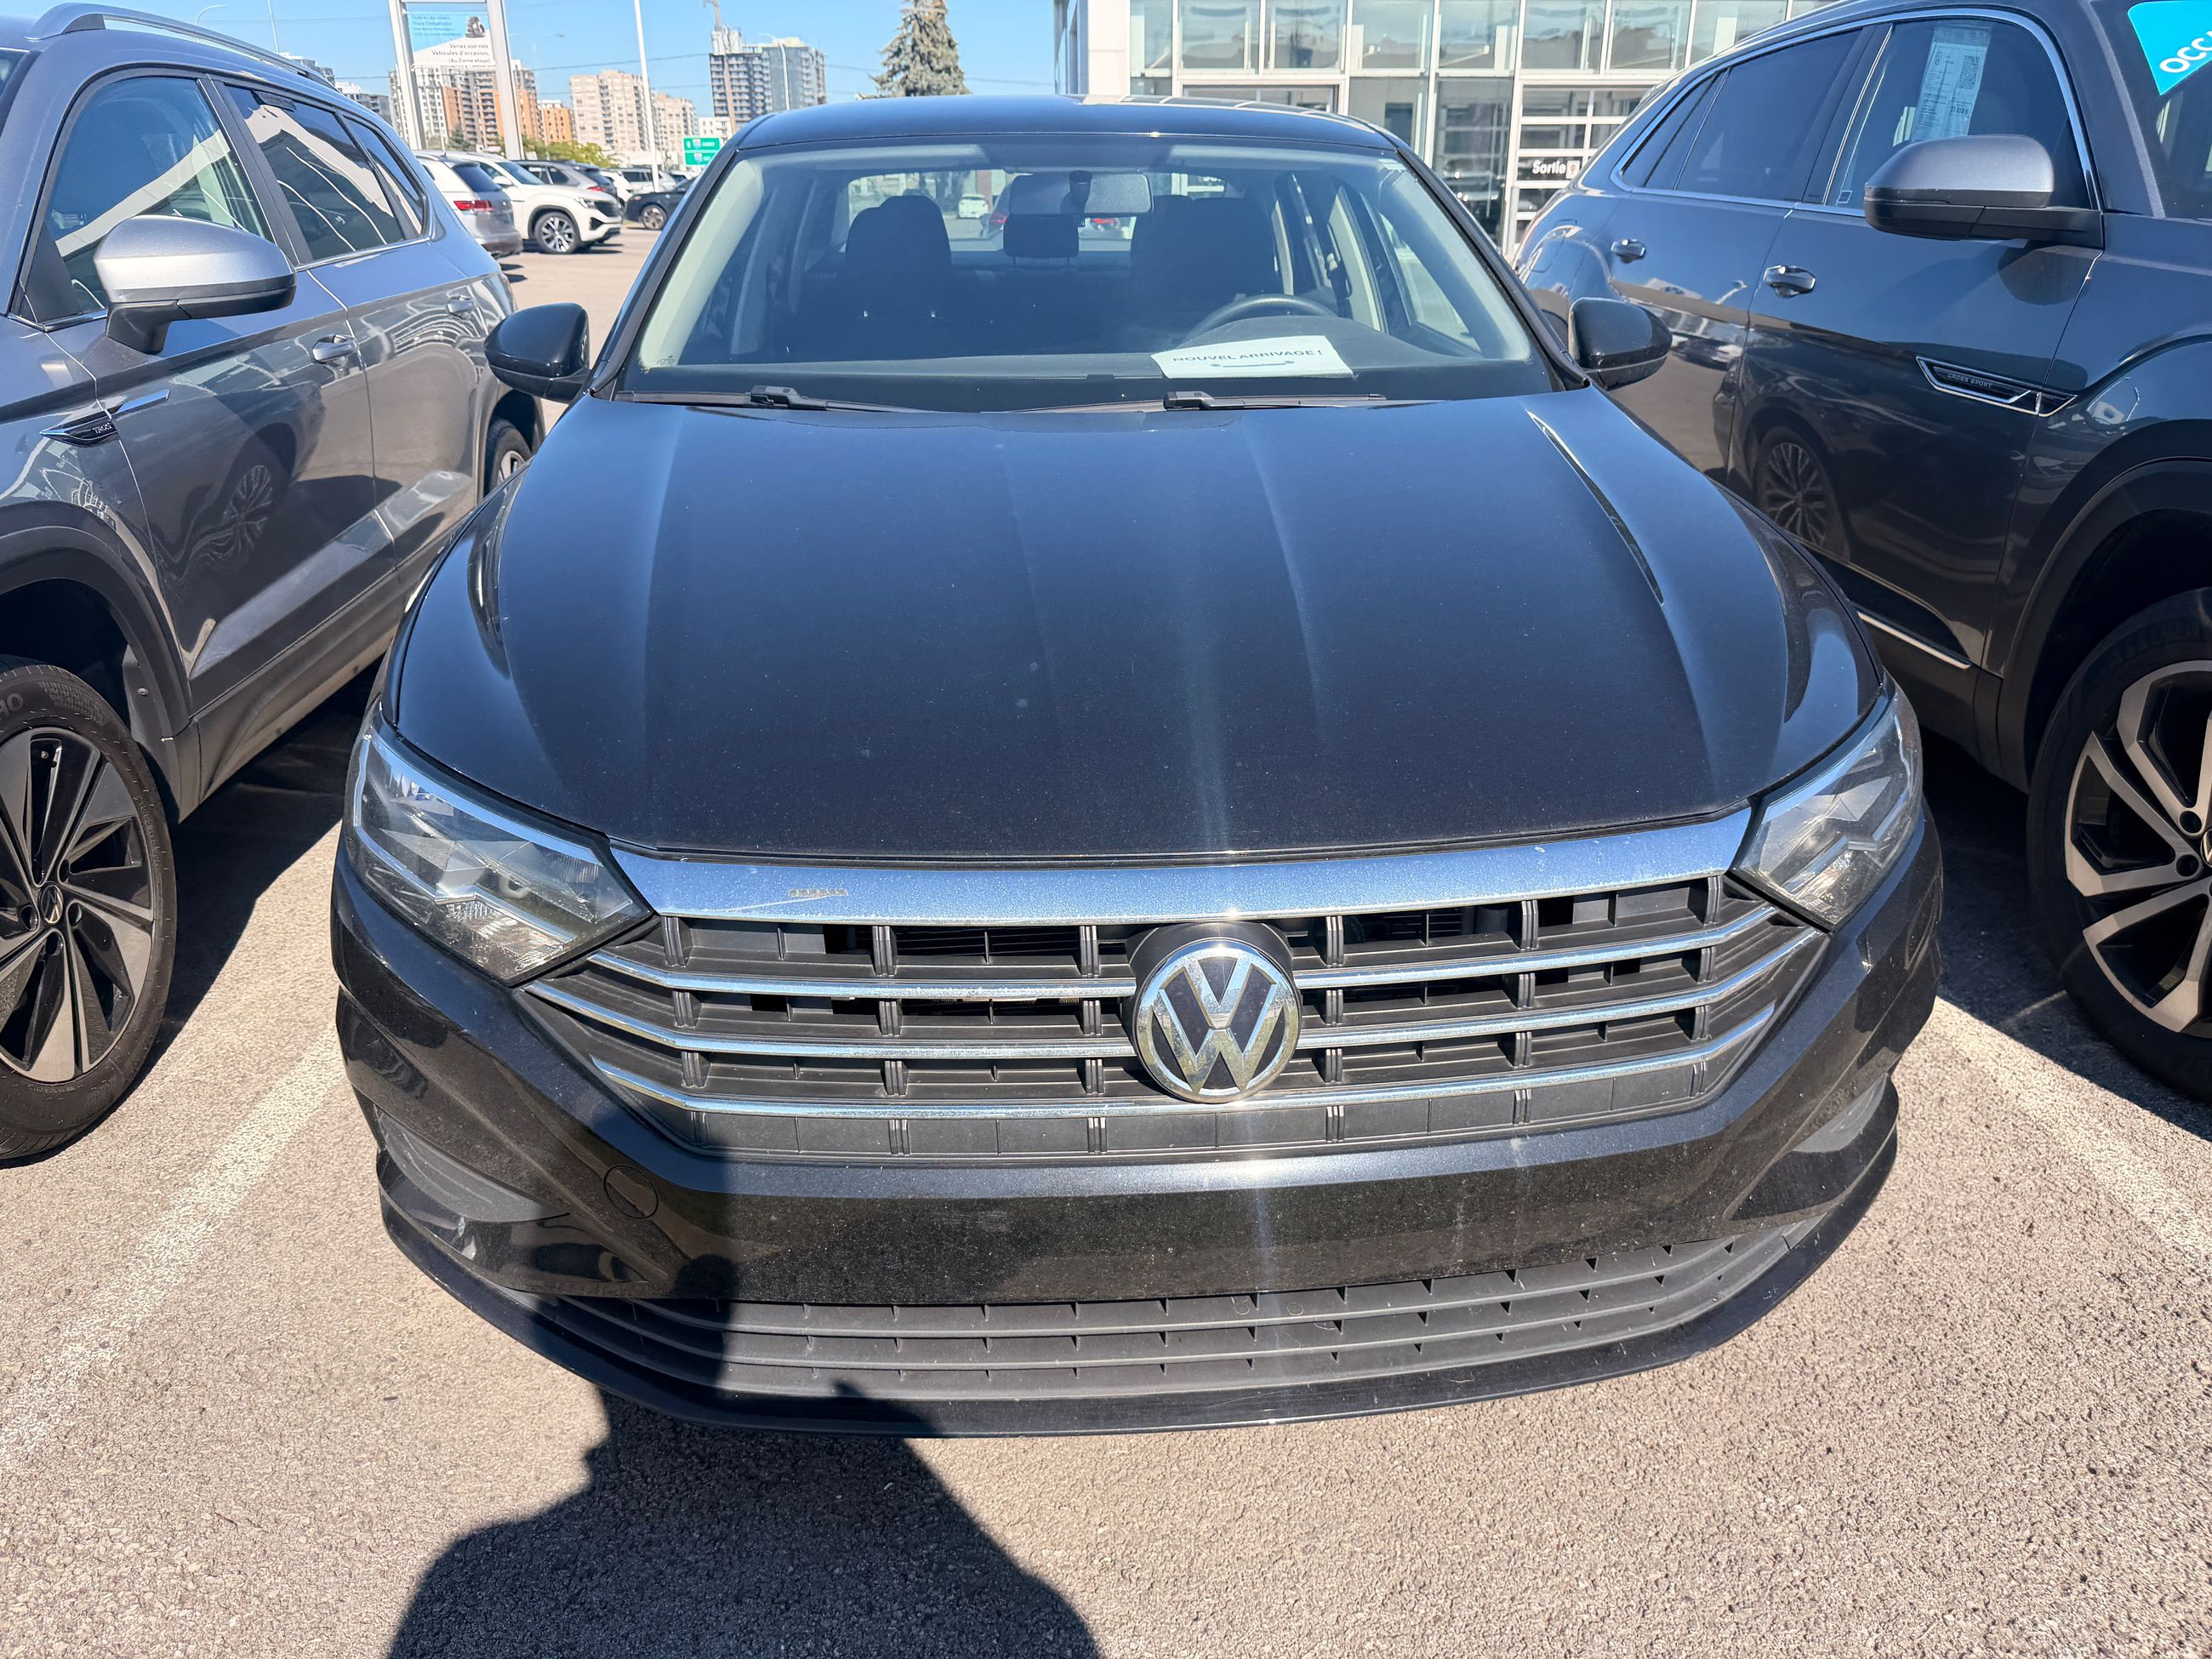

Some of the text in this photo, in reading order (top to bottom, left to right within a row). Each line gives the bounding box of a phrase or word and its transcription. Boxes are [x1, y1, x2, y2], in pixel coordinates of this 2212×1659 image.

[2159, 31, 2212, 73] OCC
[1532, 160, 1566, 174] Sortie
[1240, 351, 1315, 359] ARRIVAGE
[1947, 373, 1993, 389] CROSS SPORT
